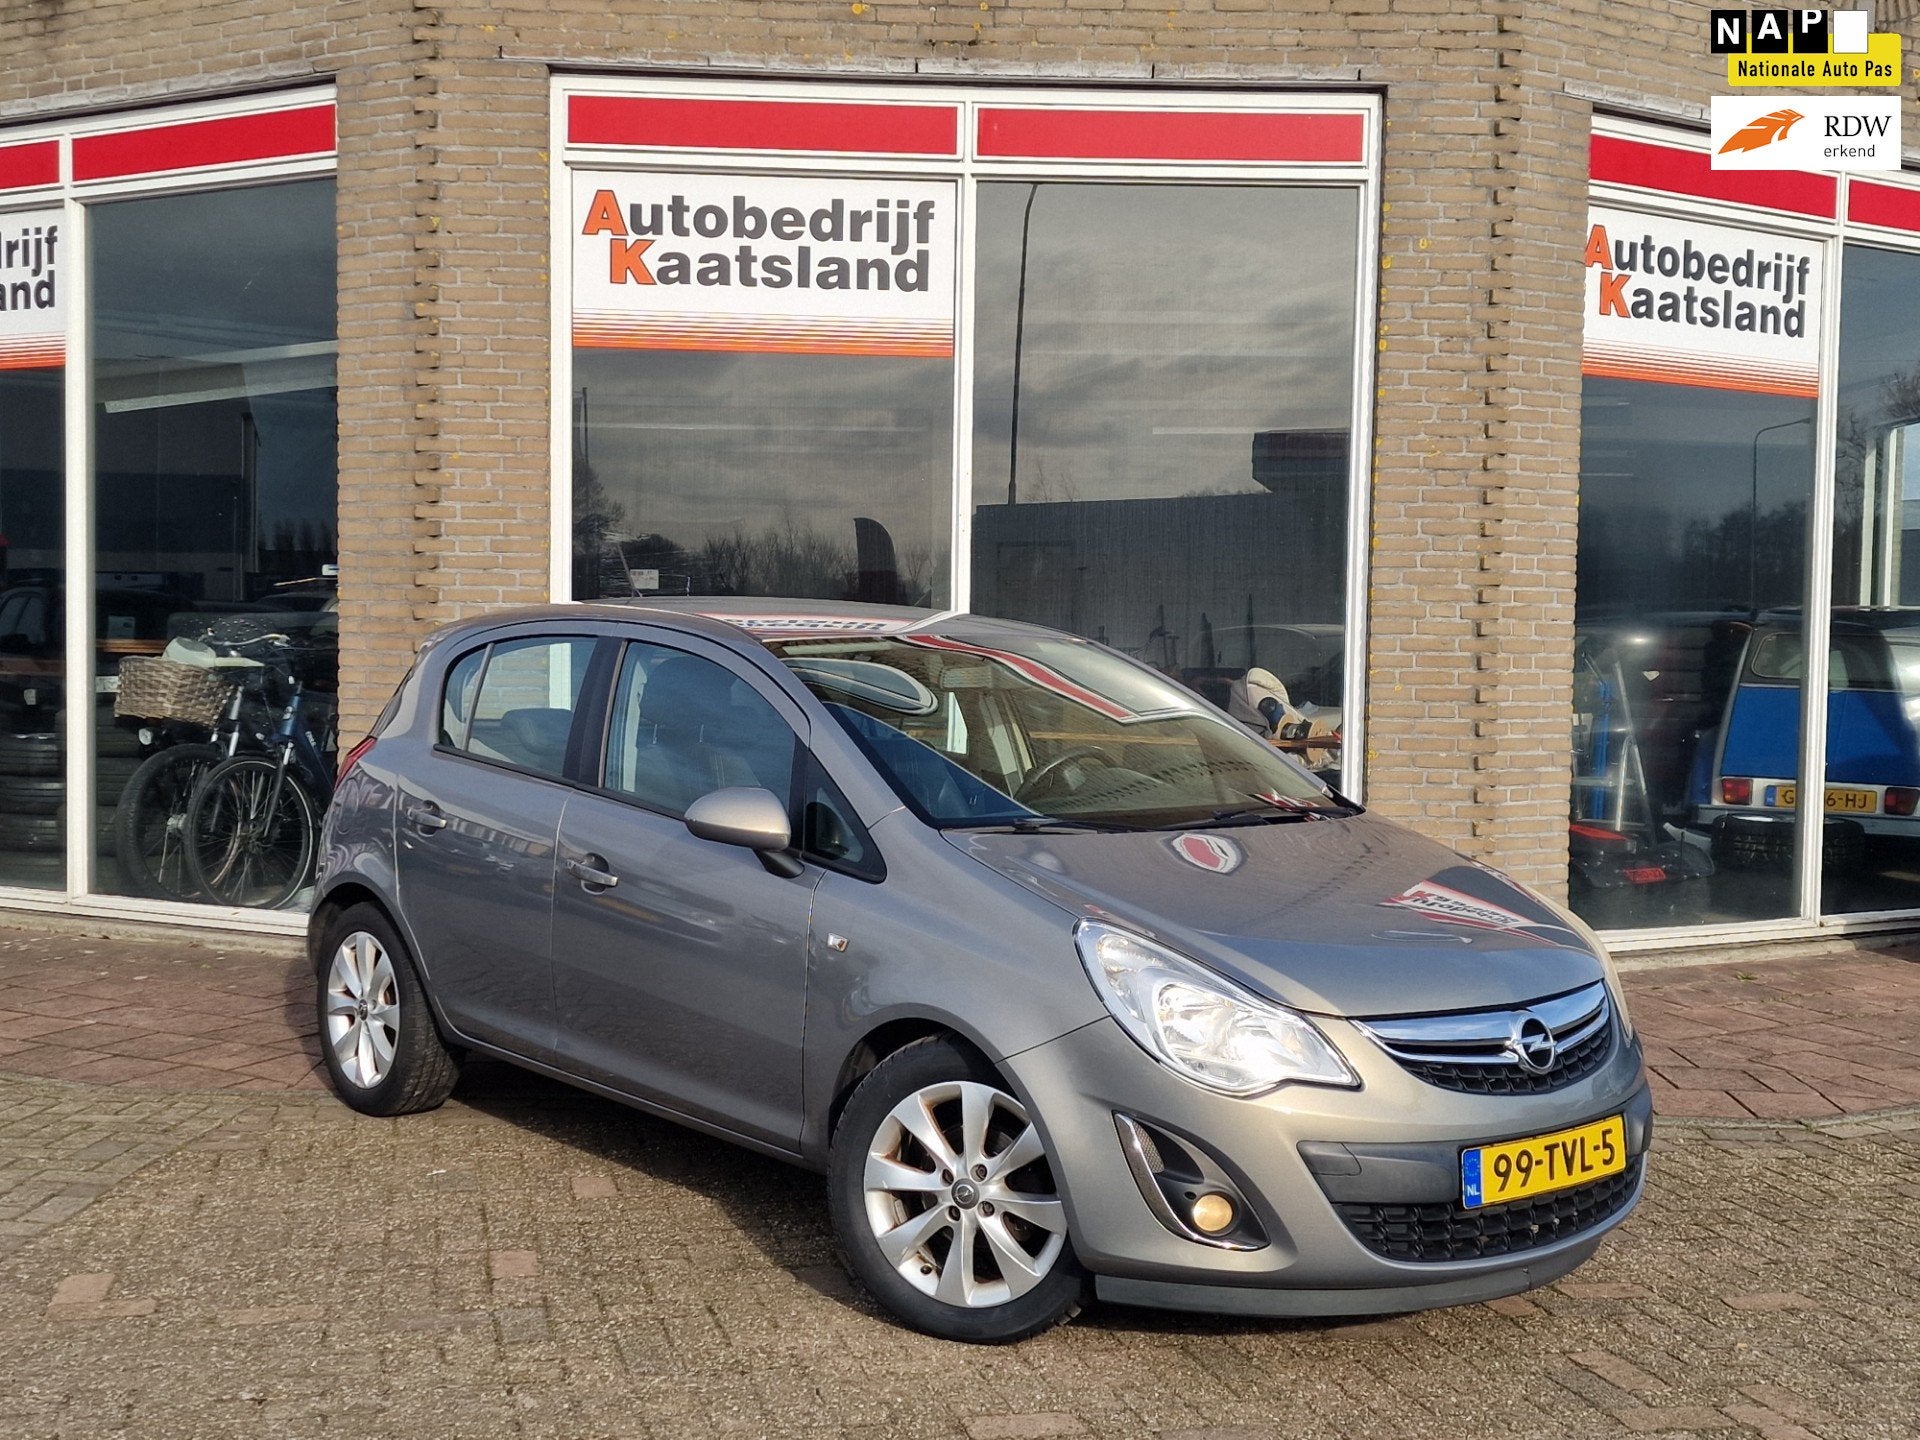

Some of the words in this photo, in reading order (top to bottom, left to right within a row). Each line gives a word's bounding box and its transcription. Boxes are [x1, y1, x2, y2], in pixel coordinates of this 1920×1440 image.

[0, 225, 58, 277] rijf
[582, 189, 935, 255] Autobedrijf
[610, 238, 929, 292] Kaatsland
[1585, 224, 1810, 303] Autobedrijf
[1600, 271, 1806, 338] Kaatsland
[1466, 1183, 1481, 1197] NL
[1493, 1127, 1616, 1193] 99-TVL-5
